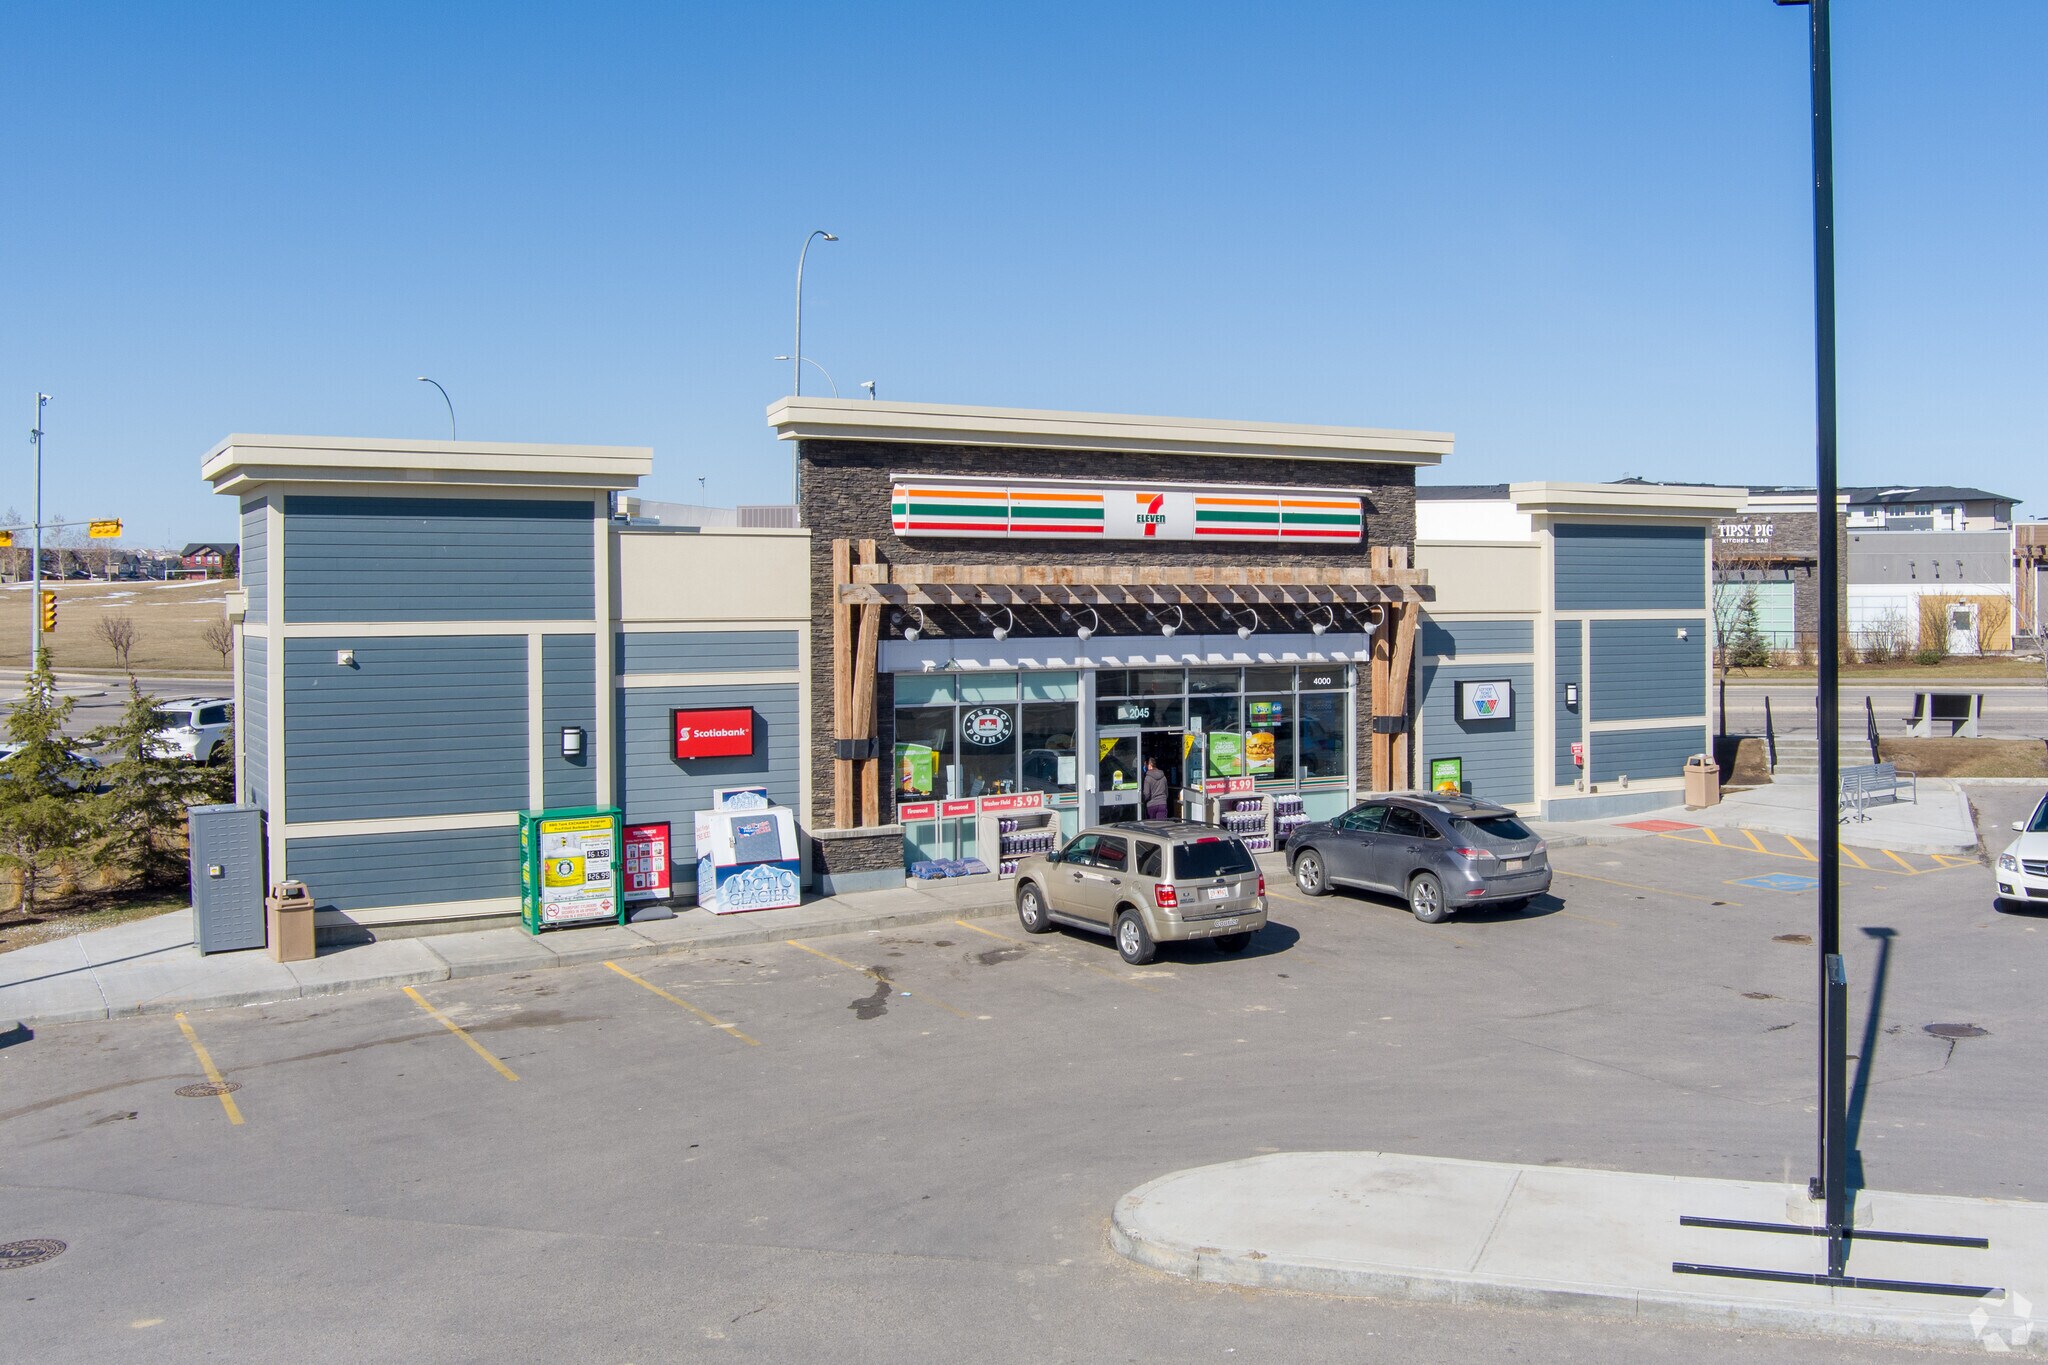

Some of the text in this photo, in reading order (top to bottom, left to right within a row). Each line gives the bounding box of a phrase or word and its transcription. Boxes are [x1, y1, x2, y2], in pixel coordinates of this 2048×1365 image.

[1135, 493, 1164, 536] 7
[1717, 524, 1773, 537] TIPSY PIG
[1313, 677, 1331, 685] 4000
[970, 709, 1007, 720] PETRO
[1129, 707, 1150, 719] 2045
[693, 727, 746, 738] Scotiabank
[967, 729, 1009, 743] POINTS
[1013, 795, 1040, 807] $5.99
[729, 871, 792, 893] ARCTIC
[729, 889, 792, 905] GLACIER
